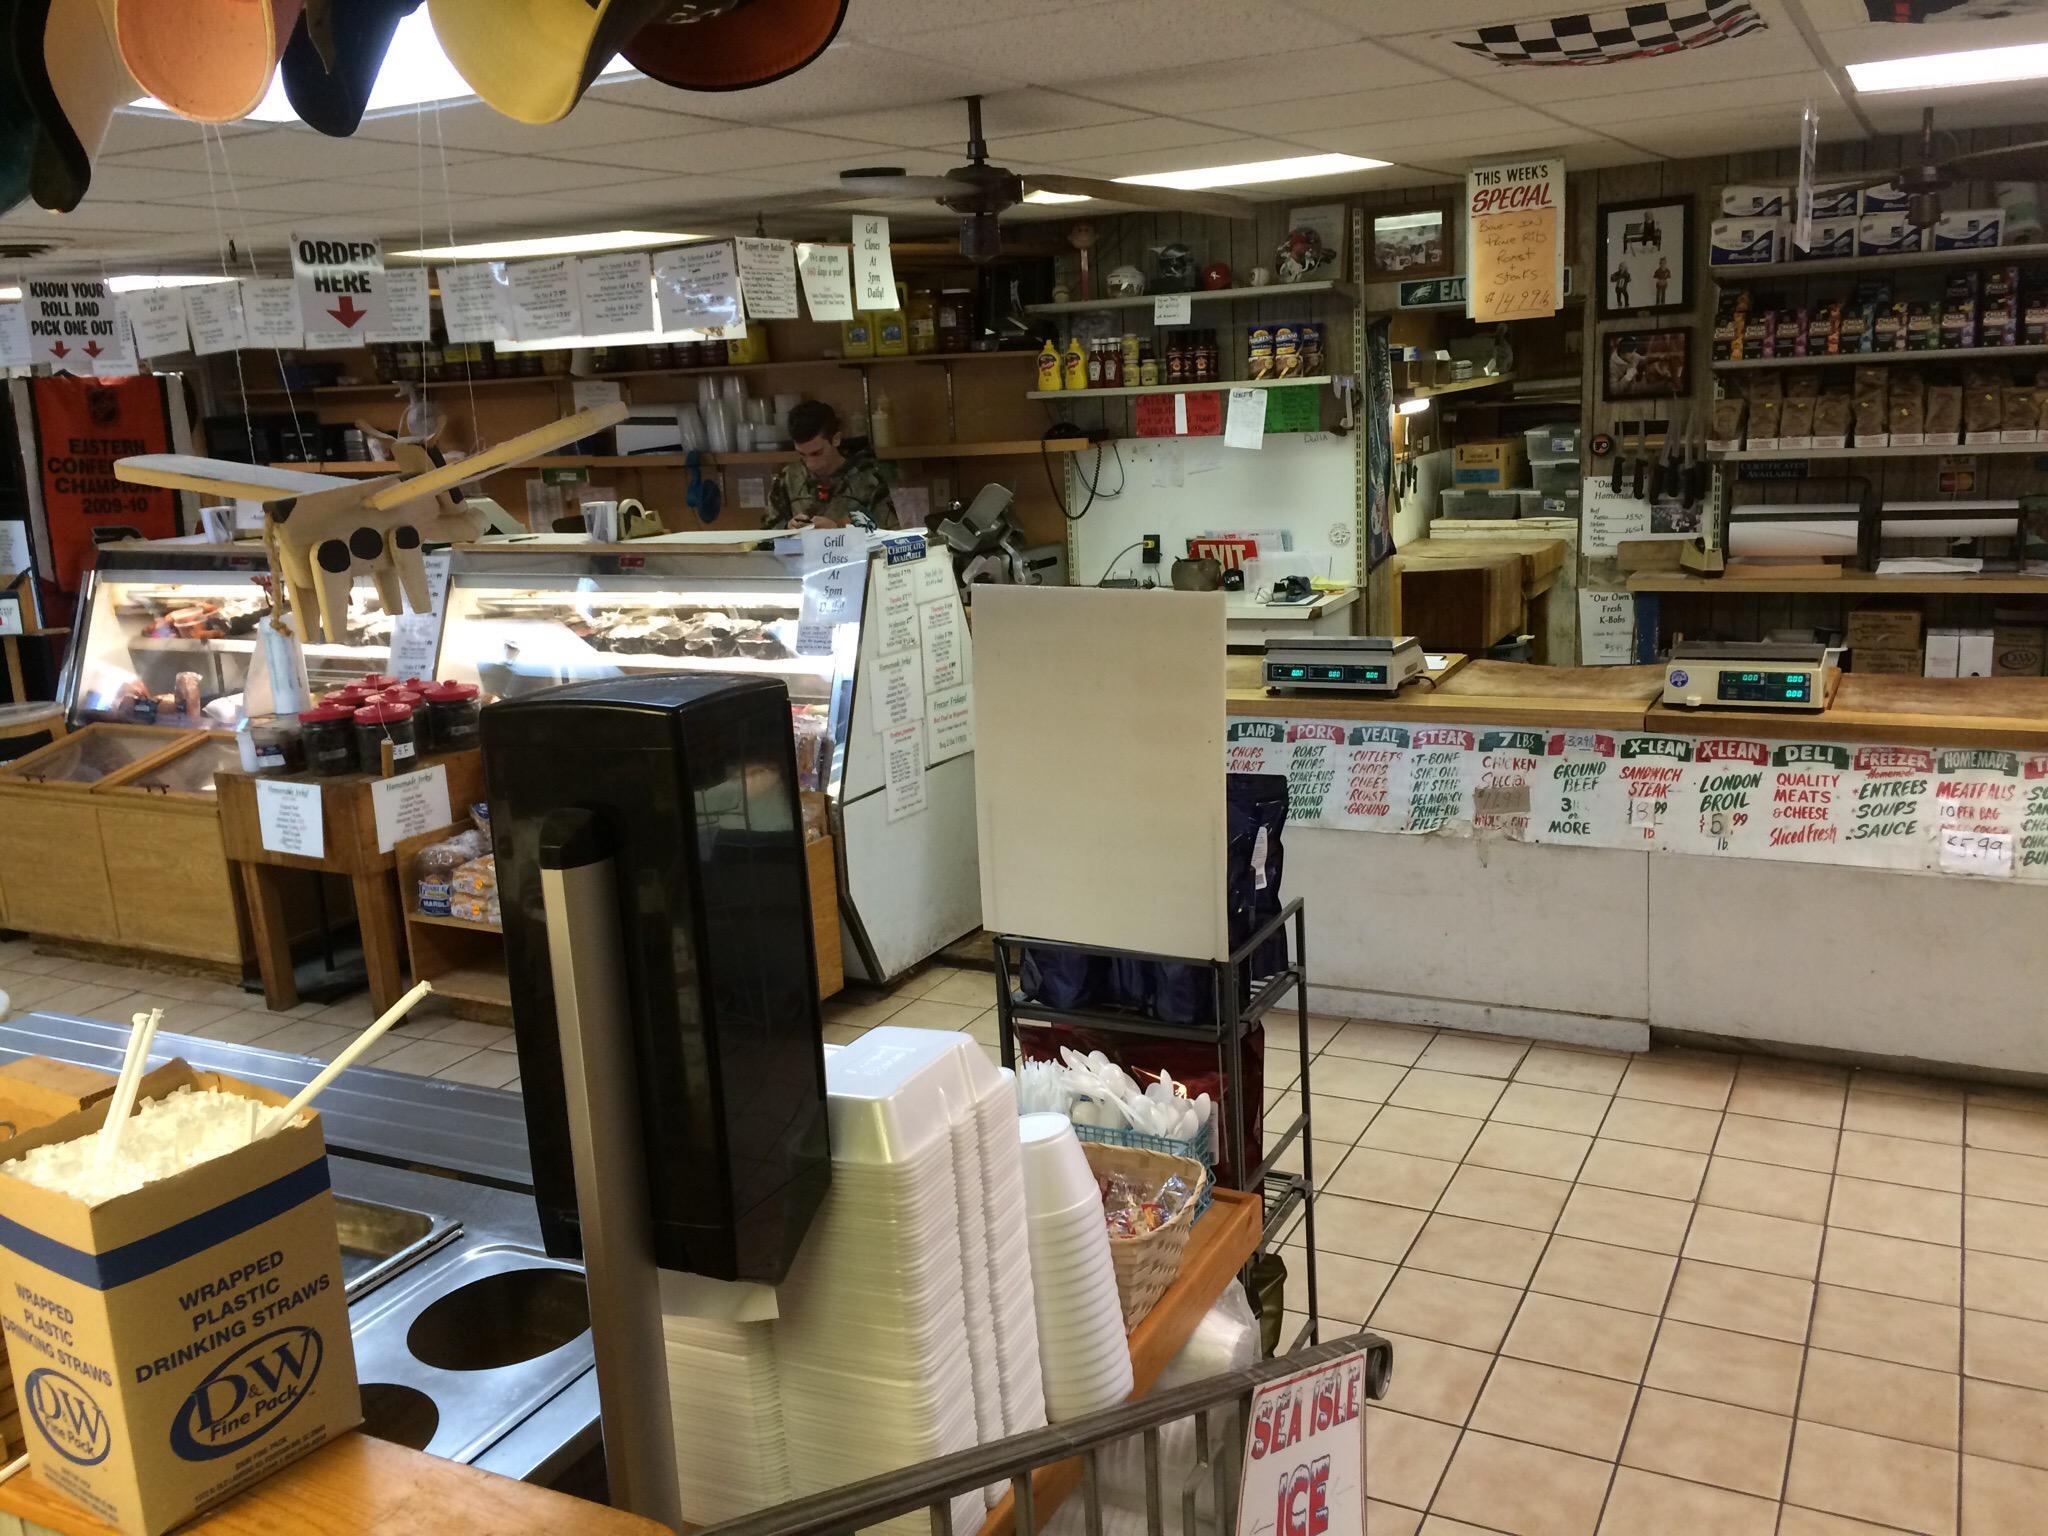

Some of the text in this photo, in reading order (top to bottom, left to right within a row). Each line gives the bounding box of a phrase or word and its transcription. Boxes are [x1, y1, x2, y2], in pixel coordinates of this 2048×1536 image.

[1475, 165, 1548, 186] THIS WEEK'S
[1472, 183, 1552, 212] SPECIAL
[866, 223, 878, 234] Grill
[299, 240, 377, 265] ORDER
[865, 240, 881, 251] Closes
[869, 257, 877, 267] At
[30, 282, 105, 299] KNOW YOUR
[314, 271, 372, 293] HERE
[41, 301, 100, 317] ROLL AND
[31, 320, 62, 336] PICK
[64, 321, 88, 336] ONE
[91, 321, 114, 336] OUT
[82, 497, 148, 514] 2009-10
[824, 534, 845, 549] Grill
[822, 553, 849, 564] Closes
[828, 569, 840, 580] At
[824, 586, 843, 598] 5pm
[1602, 603, 1622, 613] Fresh
[1238, 723, 1276, 738] LAMB
[1296, 725, 1336, 740] PORK
[1361, 727, 1399, 743] VEAL
[1417, 729, 1468, 746] STEAK
[1499, 732, 1512, 745] 7
[1231, 746, 1264, 758] CHOPS
[1292, 746, 1326, 758] ROAST
[1353, 750, 1402, 762] CUTLETS
[1629, 740, 1687, 757] X-LEAN
[1701, 740, 1760, 761] X-LEAN
[1785, 746, 1834, 762] DELI
[1229, 760, 1265, 772] ROAST
[1482, 755, 1537, 772] CHICKEN
[1860, 752, 1928, 769] FREEZER
[1944, 751, 2013, 770] HOMEMADE
[1351, 764, 1389, 776] CHOPS
[1553, 761, 1607, 780] GROUND
[1618, 766, 1684, 783] SANDWICH
[1288, 783, 1330, 795] CUTLETS
[1563, 776, 1601, 793] BEEF
[1699, 772, 1763, 794] LONDON
[1776, 772, 1841, 789] QUALITY
[1350, 789, 1388, 802] ROAST
[1628, 782, 1670, 799] STEAK
[1773, 788, 1832, 804] MEATS
[1858, 779, 1928, 800] ENTREES
[1347, 803, 1390, 817] GROUND
[1411, 805, 1461, 818] PRIME-RIB
[1561, 797, 1572, 812] 3
[1700, 792, 1751, 814] BROIL
[1856, 800, 1918, 819] SOUPS
[1287, 808, 1322, 820] CROWN
[1979, 806, 2001, 821] BAG
[1410, 817, 1448, 831] FILET
[1548, 820, 1591, 835] MORE
[1854, 820, 1918, 839] SAUCE
[1769, 823, 1838, 847] Sliced Fresh
[179, 1250, 285, 1313] WRAPPED
[14, 1282, 74, 1325] WRAPPED
[192, 1277, 281, 1332] PLASTIC
[23, 1308, 74, 1347] PLASTIC
[135, 1273, 331, 1384] DRINKING STRAWS
[2, 1315, 113, 1387] DRINKING STRAWS
[197, 1331, 315, 1432] D&W
[209, 1384, 299, 1442] Fine Pack
[1251, 1366, 1361, 1460] SEA ISLE
[67, 1428, 95, 1455] Pack
[1276, 1454, 1331, 1536] ICE
